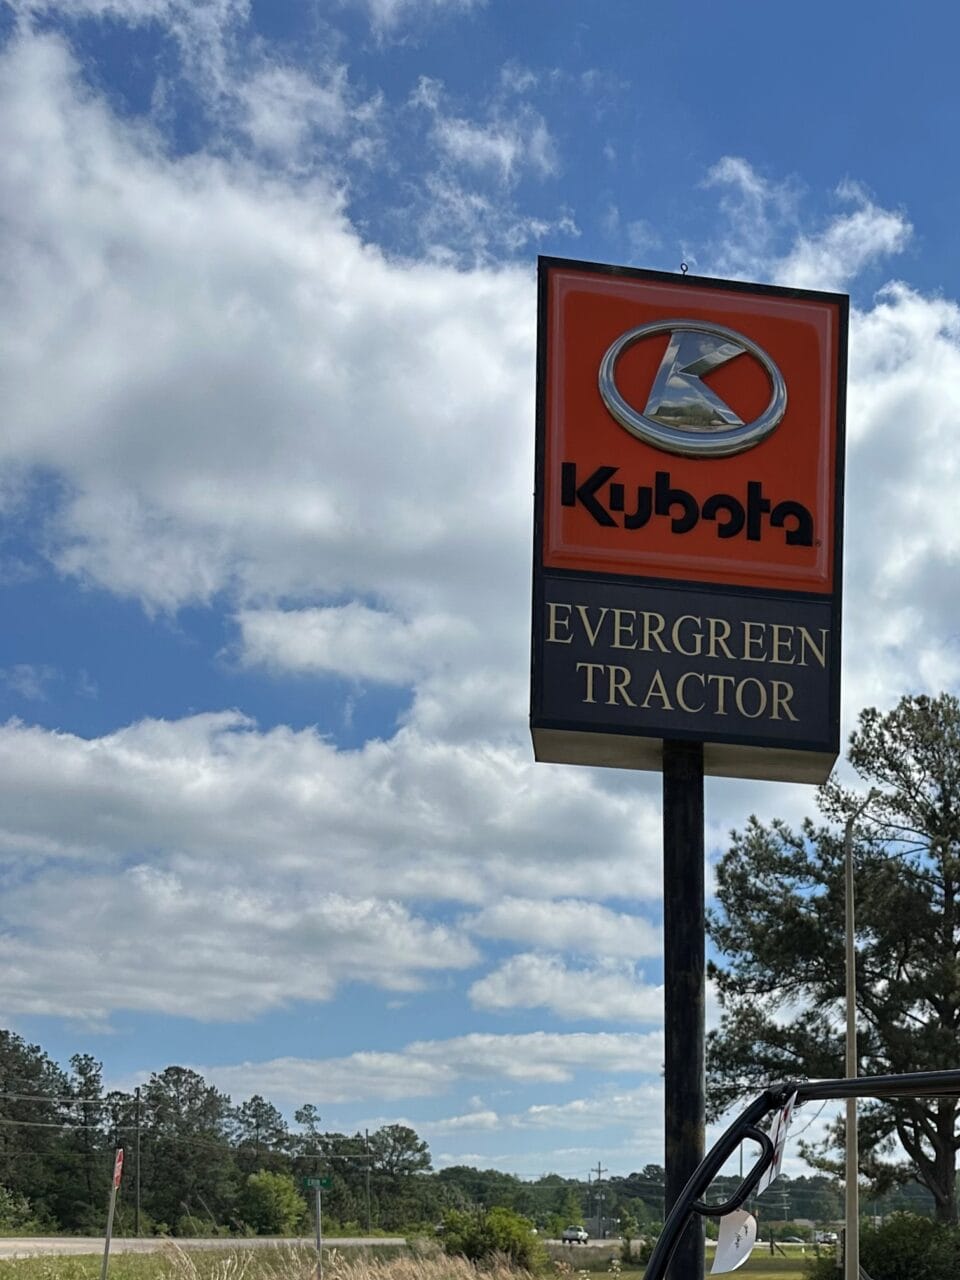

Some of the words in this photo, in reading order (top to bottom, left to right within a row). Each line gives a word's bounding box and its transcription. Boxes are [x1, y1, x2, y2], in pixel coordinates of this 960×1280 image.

[561, 462, 814, 547] Kubota
[545, 602, 830, 669] EVERGREEN
[576, 662, 800, 721] TRACTOR
